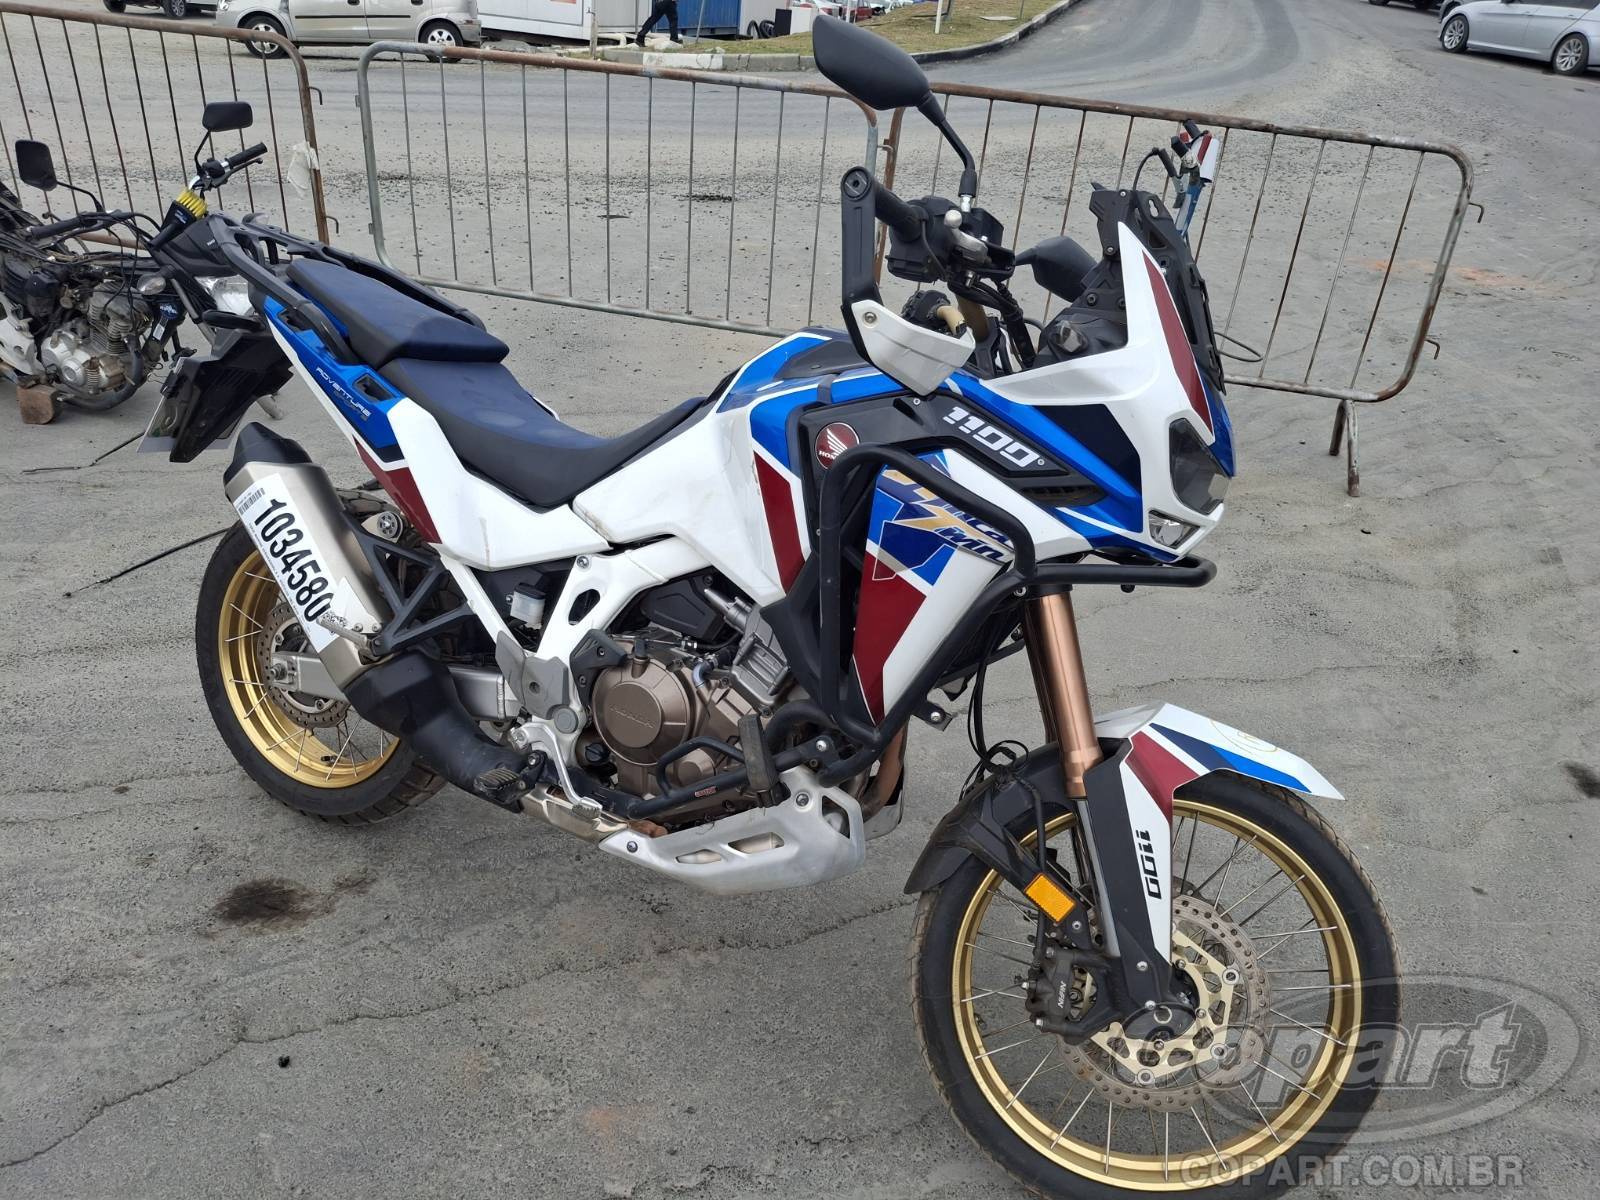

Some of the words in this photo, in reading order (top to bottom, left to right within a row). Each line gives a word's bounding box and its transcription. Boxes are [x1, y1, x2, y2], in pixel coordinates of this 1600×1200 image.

[316, 366, 372, 417] ADVENTURE
[943, 406, 1041, 468] 1100
[254, 498, 335, 623] 1034580
[1136, 829, 1162, 899] 1100
